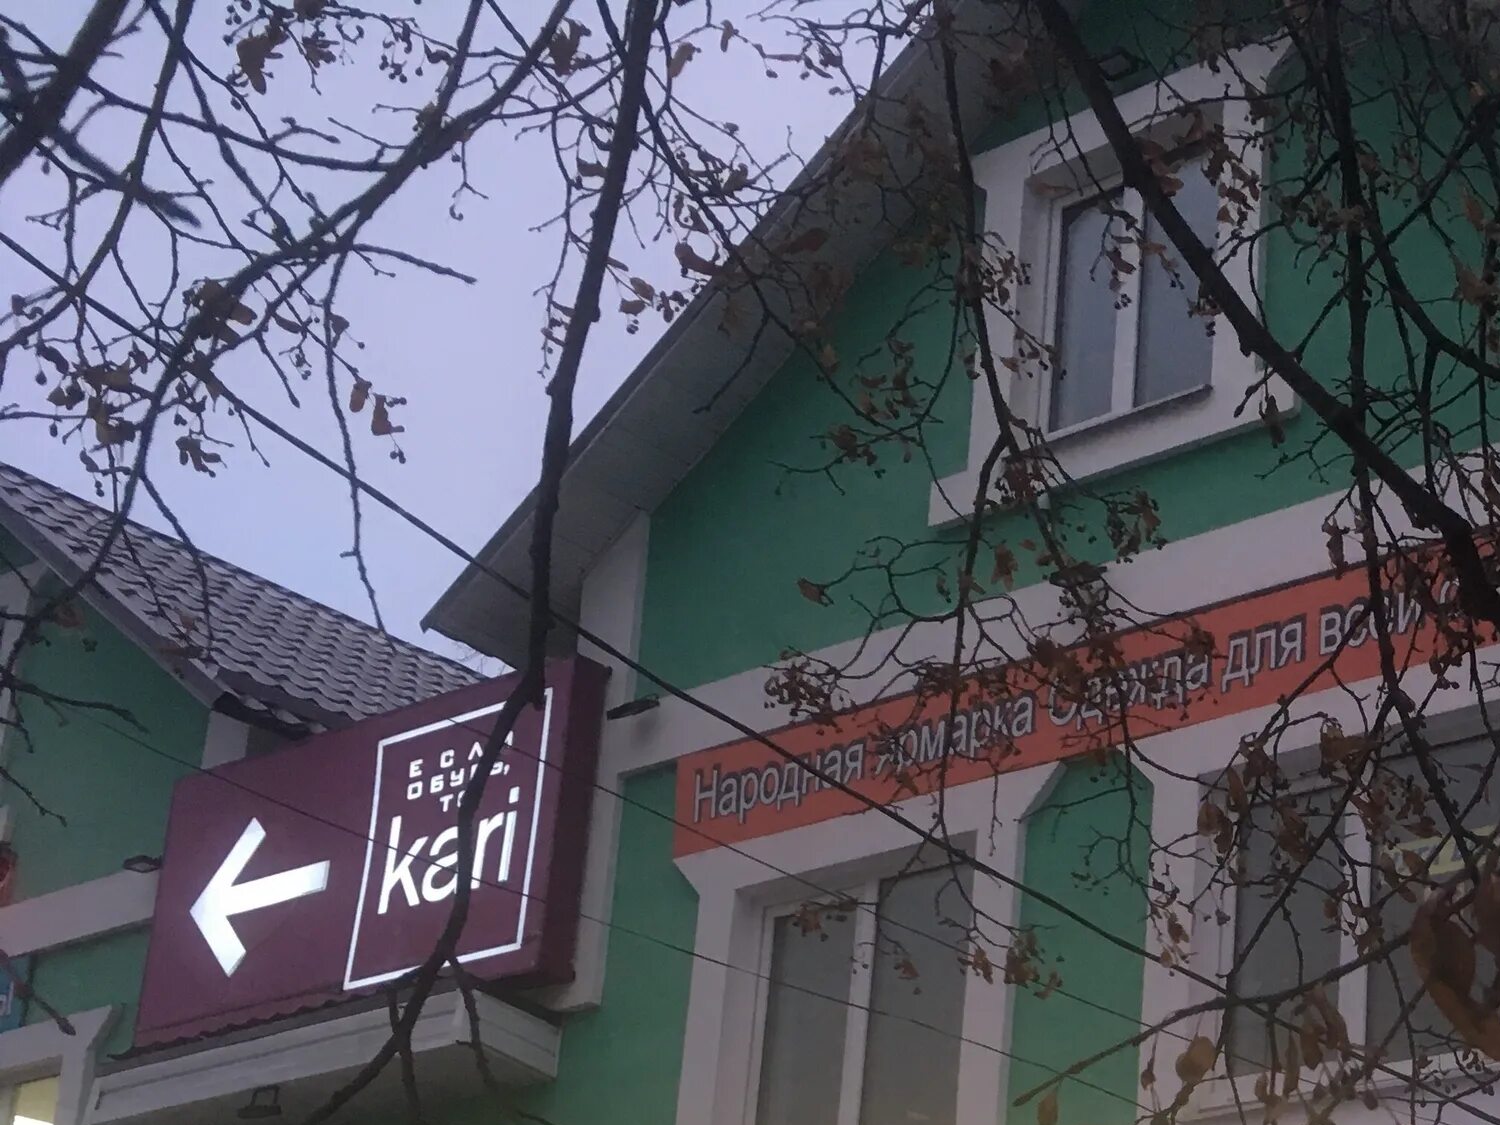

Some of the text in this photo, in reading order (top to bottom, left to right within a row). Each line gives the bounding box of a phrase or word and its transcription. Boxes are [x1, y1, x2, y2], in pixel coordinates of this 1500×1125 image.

[407, 761, 510, 800] ОБУЬ,
[692, 740, 864, 824] Народная
[1221, 620, 1302, 693] для
[378, 786, 520, 915] kari
